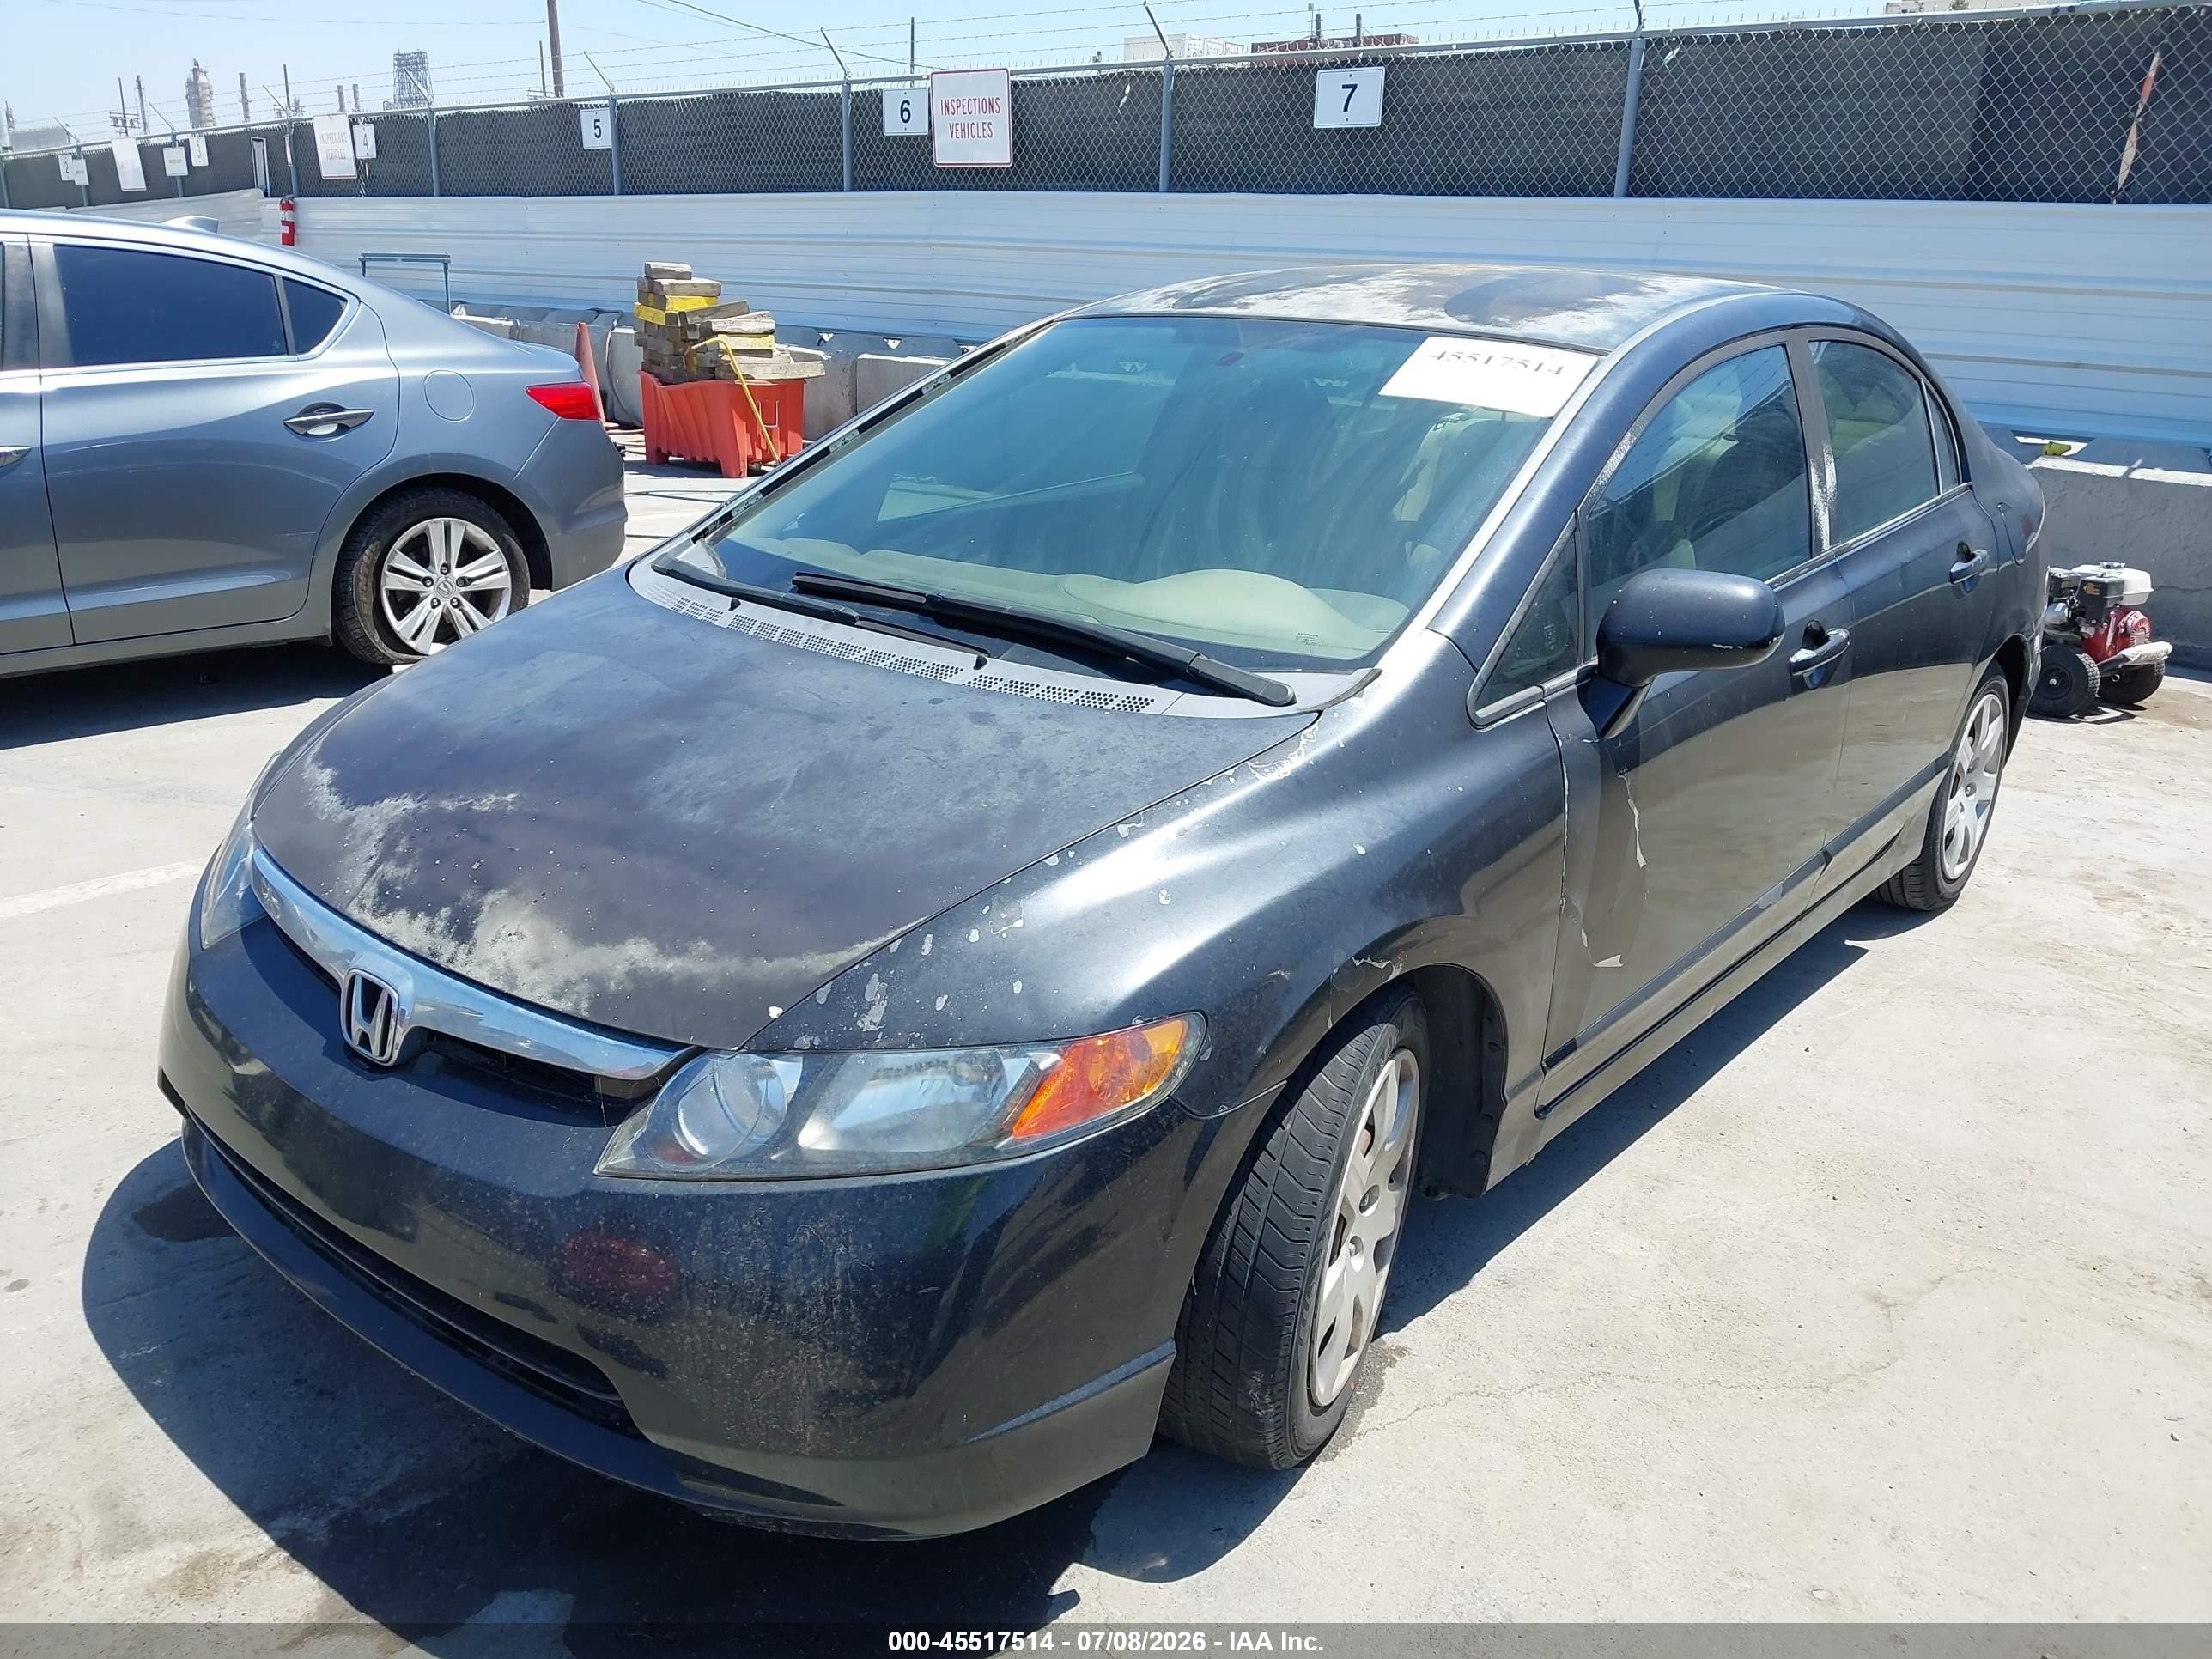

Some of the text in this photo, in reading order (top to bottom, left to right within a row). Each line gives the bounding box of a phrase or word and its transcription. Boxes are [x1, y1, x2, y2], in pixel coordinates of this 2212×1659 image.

[940, 96, 1001, 116] INSPECTIONS
[1341, 83, 1358, 112] 7
[899, 99, 912, 124] 6
[593, 118, 602, 139] 5
[948, 121, 994, 140] VEHICLES
[362, 132, 369, 149] 4
[64, 161, 70, 174] 2
[1430, 349, 1566, 376] 45517514
